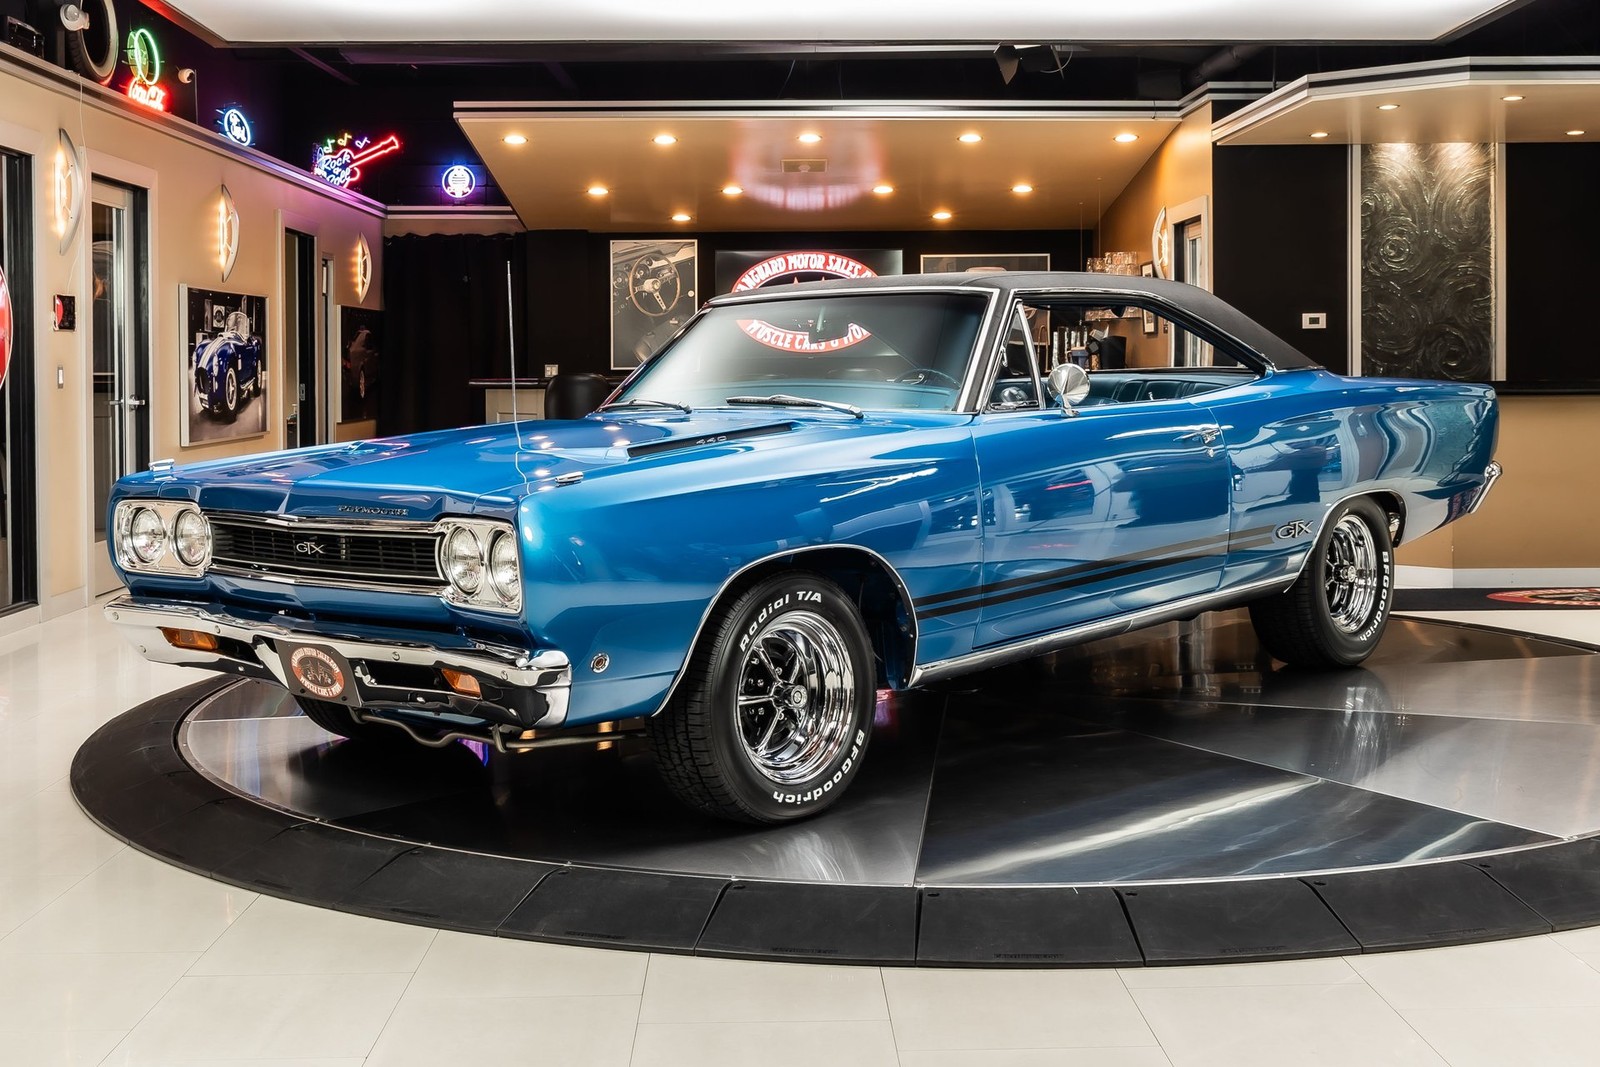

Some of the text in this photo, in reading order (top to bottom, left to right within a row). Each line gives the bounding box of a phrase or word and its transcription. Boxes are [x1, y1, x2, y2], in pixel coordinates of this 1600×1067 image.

[317, 151, 351, 170] Rock
[786, 254, 826, 270] MOTOR
[745, 319, 794, 349] MUSCLE
[696, 435, 727, 445] 440
[338, 505, 409, 515] PLYMOUTH
[1276, 520, 1314, 539] GTX
[296, 541, 325, 555] GTX
[1360, 551, 1389, 641] BFGoodrich
[740, 591, 823, 652] Radial T/A
[773, 728, 865, 804] BFGoodrich
